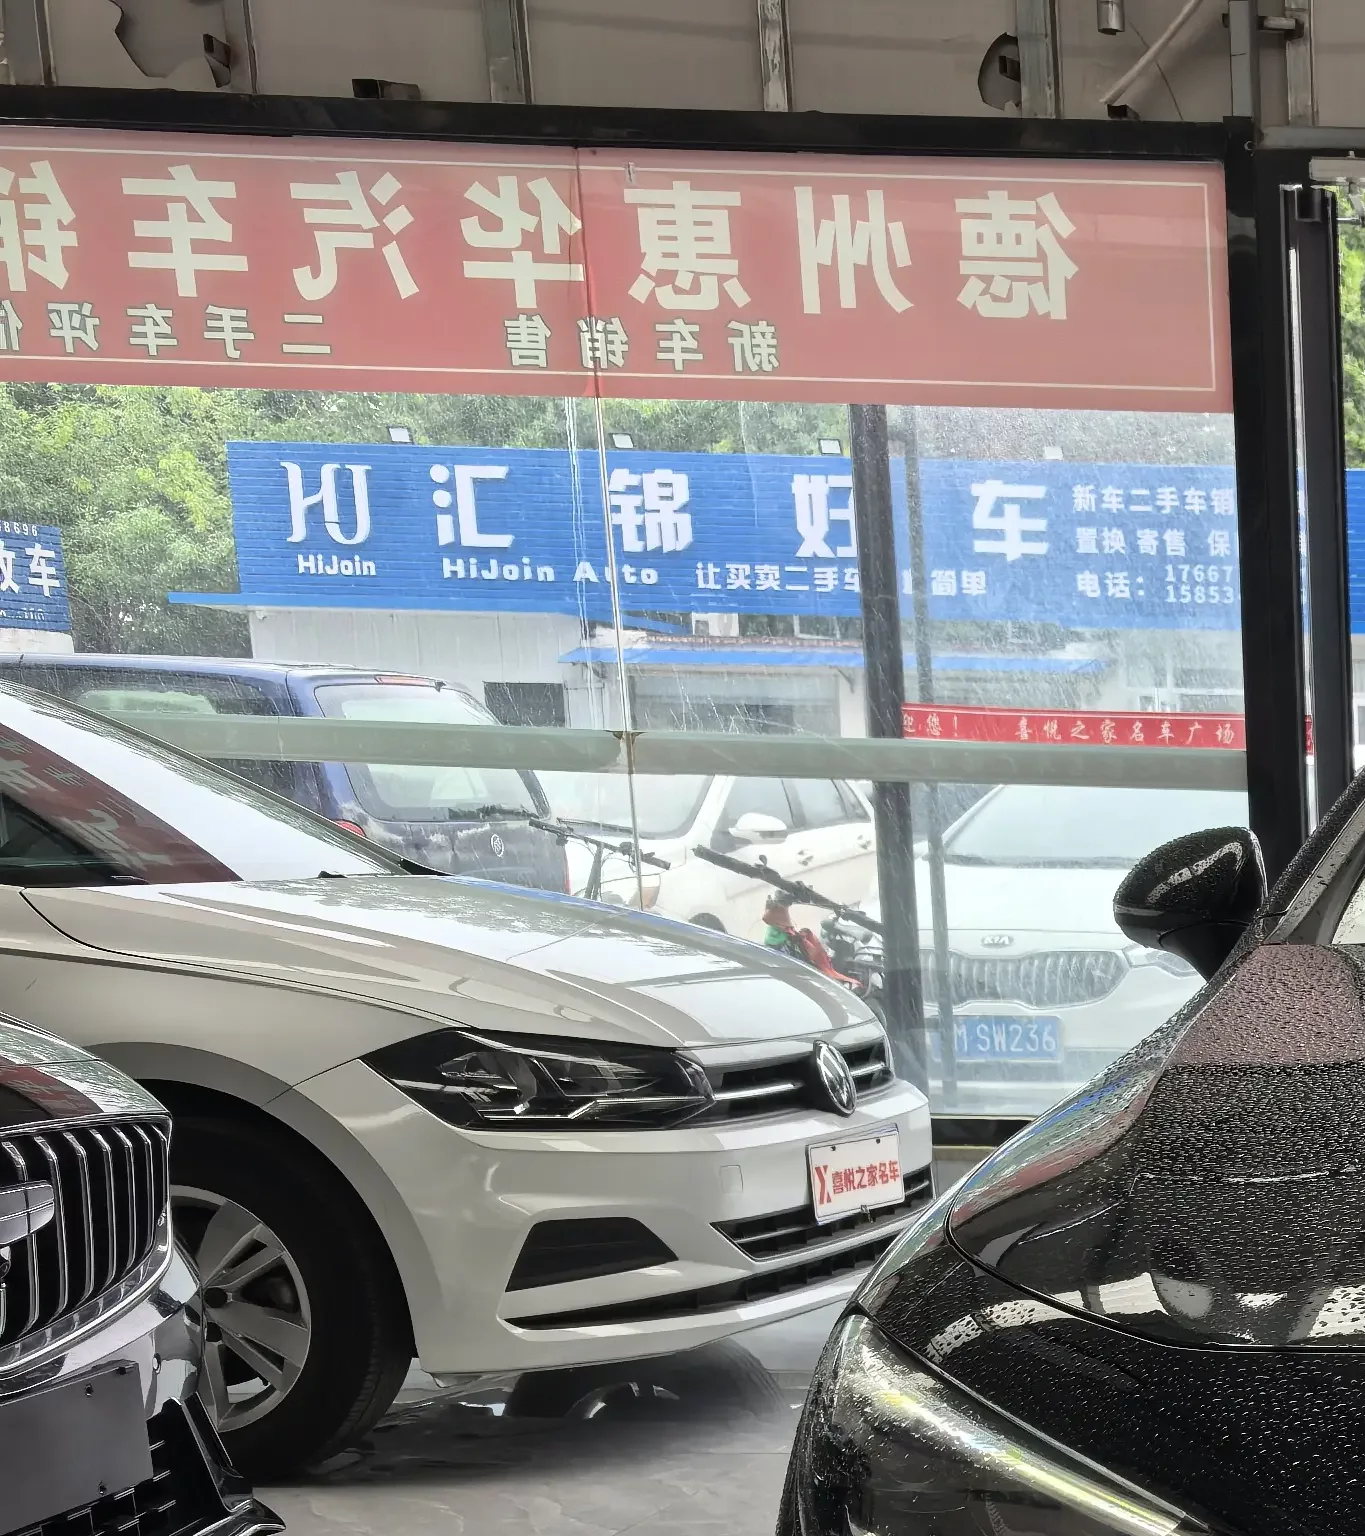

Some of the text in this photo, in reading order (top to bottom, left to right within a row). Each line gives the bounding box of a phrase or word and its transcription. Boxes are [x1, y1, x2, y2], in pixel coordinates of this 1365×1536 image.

[0, 521, 38, 537] 8696
[1076, 527, 1126, 555] 置换
[1136, 528, 1186, 557] 寄售
[297, 553, 377, 577] HiJoin
[442, 556, 555, 582] HiJoin
[1164, 563, 1234, 583] 17667
[1164, 585, 1235, 604] 15853
[953, 1023, 1057, 1054] M·SW236
